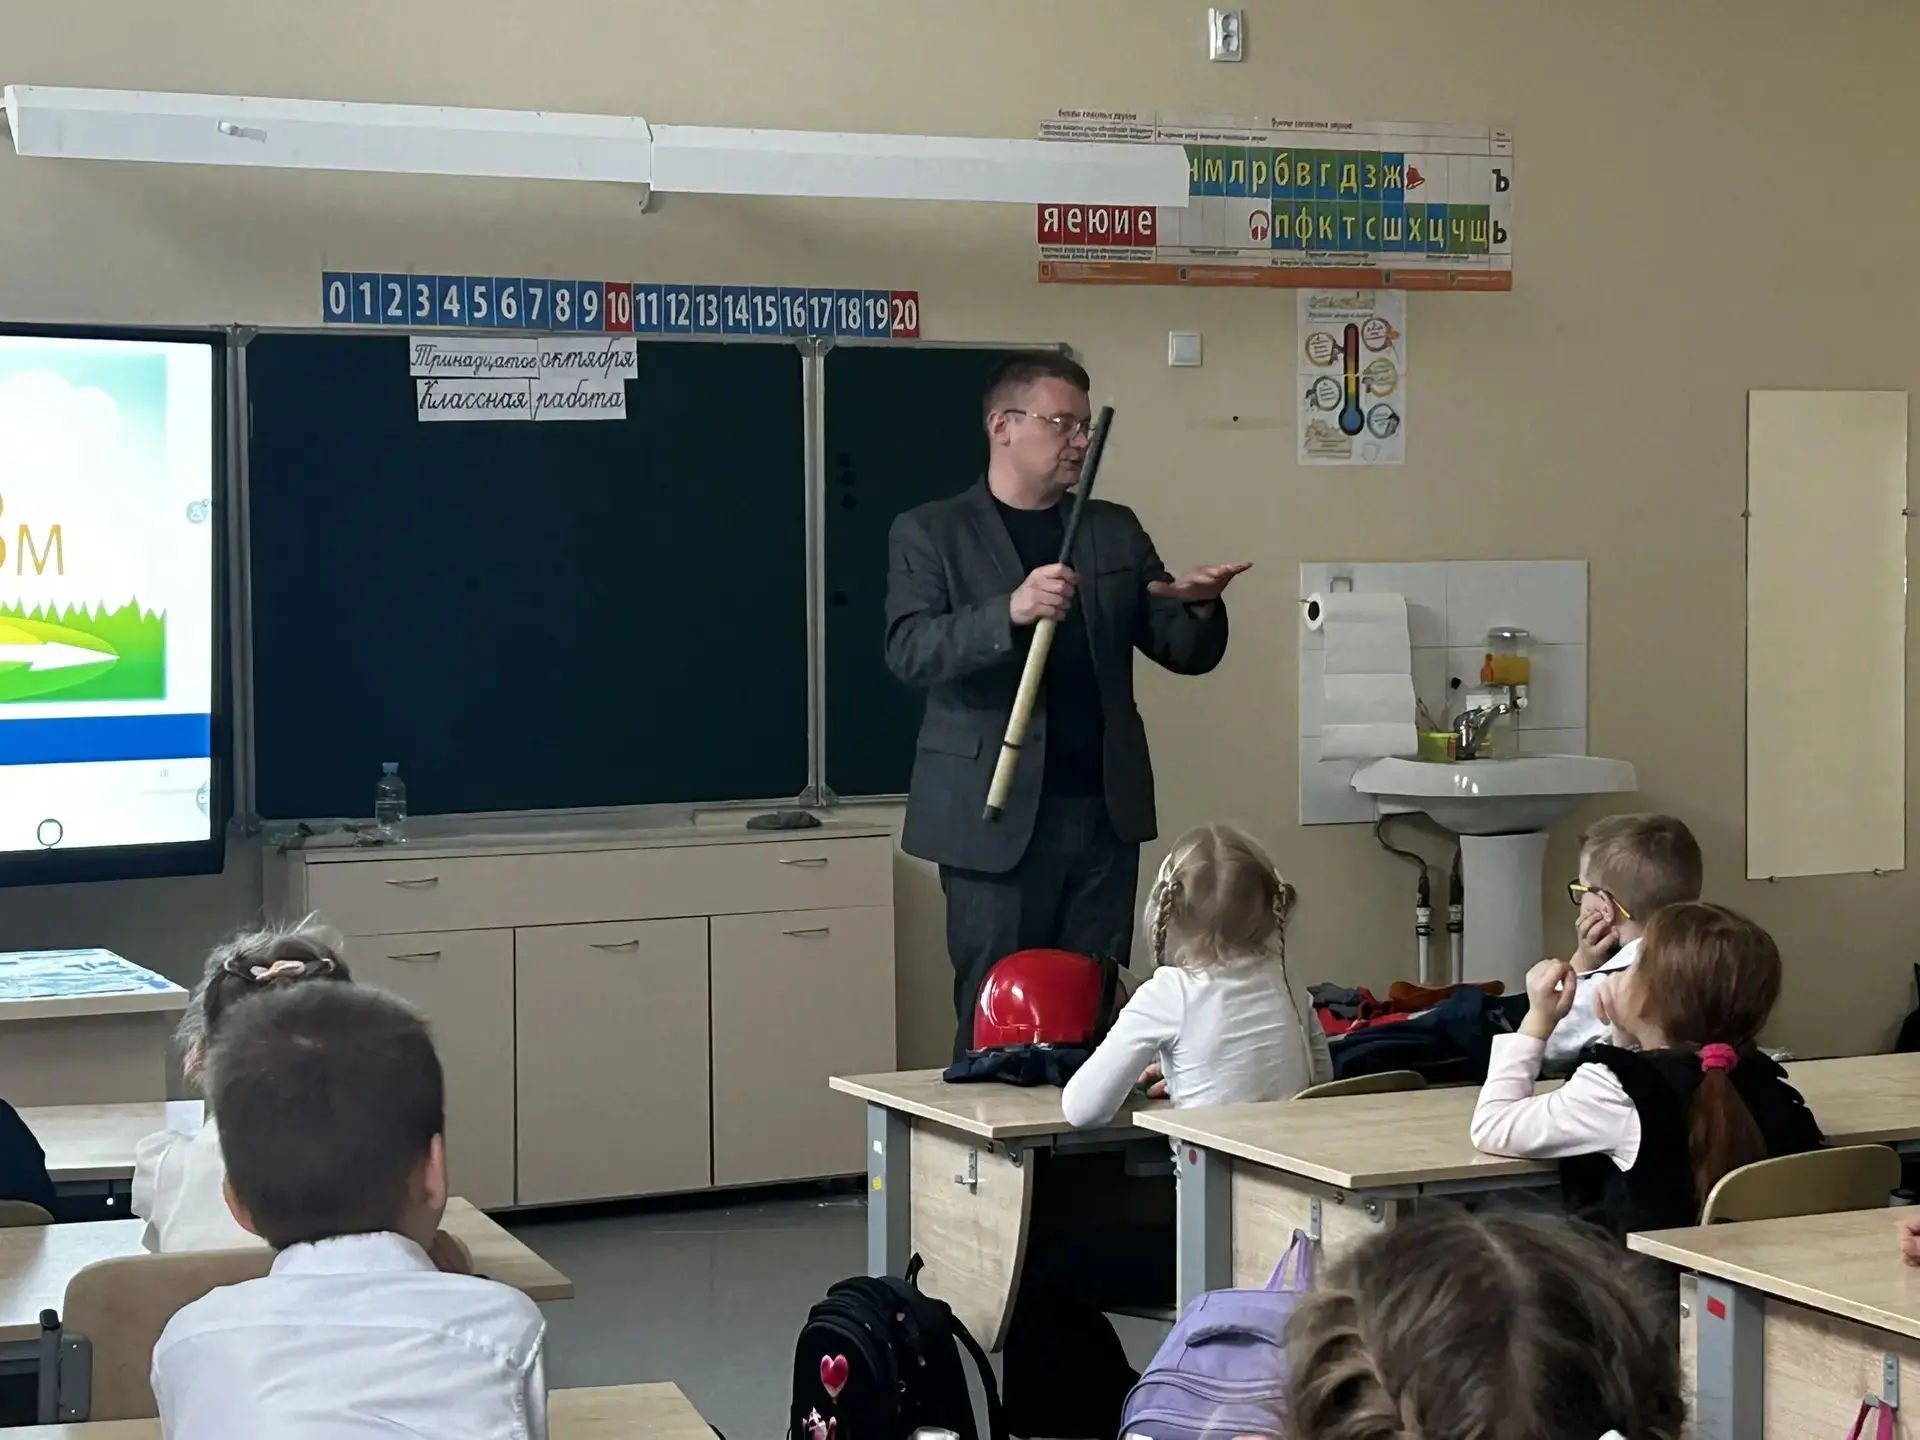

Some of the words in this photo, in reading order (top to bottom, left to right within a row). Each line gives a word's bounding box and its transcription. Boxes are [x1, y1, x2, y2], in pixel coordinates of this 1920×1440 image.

[329, 281, 345, 315] 0
[359, 282, 371, 316] 1
[387, 282, 403, 316] 2
[416, 284, 430, 317] 3
[443, 285, 461, 318] 4
[473, 285, 488, 318] 5
[501, 286, 517, 320] 6
[528, 287, 543, 320] 7
[555, 288, 571, 322] 8
[583, 290, 598, 323] 9
[607, 291, 630, 324] 10
[635, 292, 658, 325] 11
[666, 293, 690, 325] 12
[695, 294, 718, 326] 13
[724, 295, 749, 327] 14
[752, 295, 777, 327] 15
[782, 296, 805, 328] 16
[810, 297, 833, 328] 17
[837, 297, 861, 329] 18
[865, 298, 889, 330] 19
[892, 298, 917, 330] 20
[411, 343, 536, 376] Тринадцатое
[540, 337, 636, 379] октября
[419, 380, 528, 410] Классная
[533, 379, 624, 422] работа
